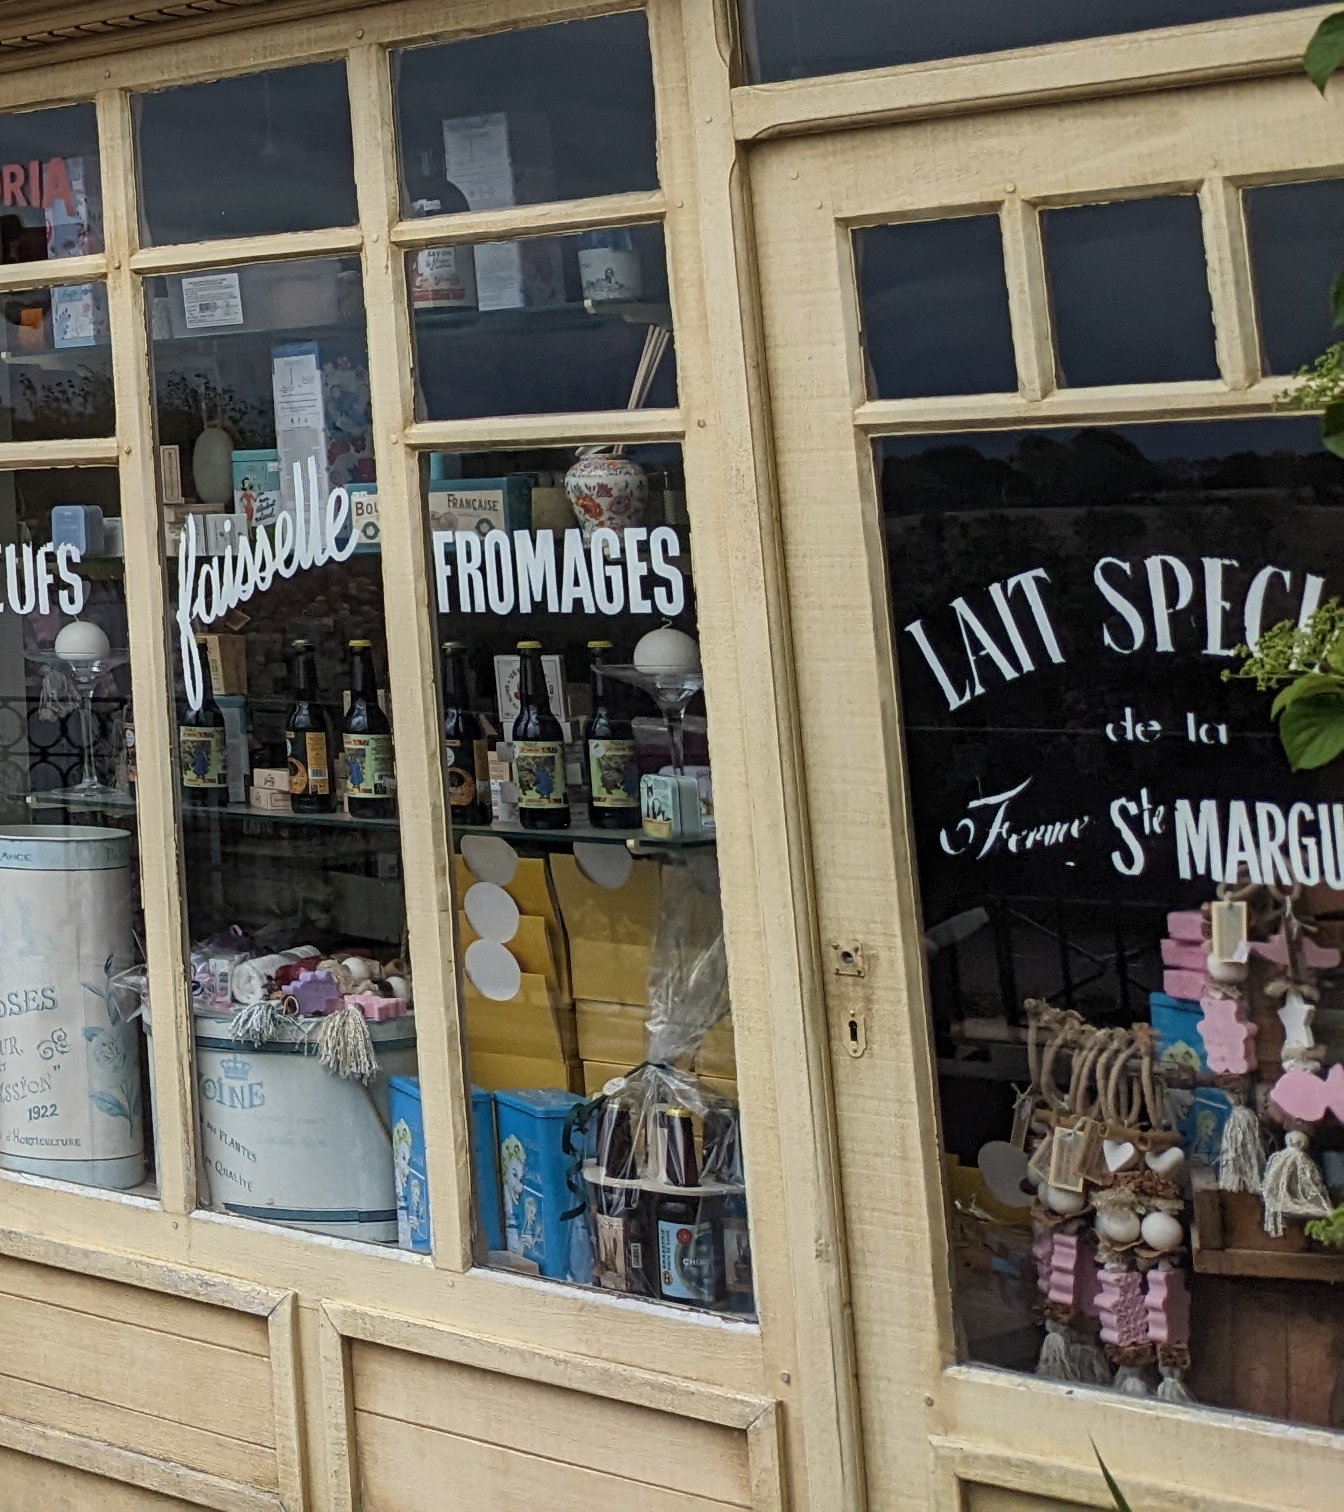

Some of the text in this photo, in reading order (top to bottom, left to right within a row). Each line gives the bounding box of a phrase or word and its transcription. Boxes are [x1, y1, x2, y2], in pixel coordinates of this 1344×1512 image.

[176, 456, 360, 711] faisselle
[432, 526, 685, 616] FROMAGES
[904, 554, 1326, 711] LAIT SPECI
[1105, 707, 1231, 744] de la
[1174, 798, 1344, 889] MARGU
[27, 1104, 59, 1122] 1922
[219, 1129, 258, 1163] PLANTES
